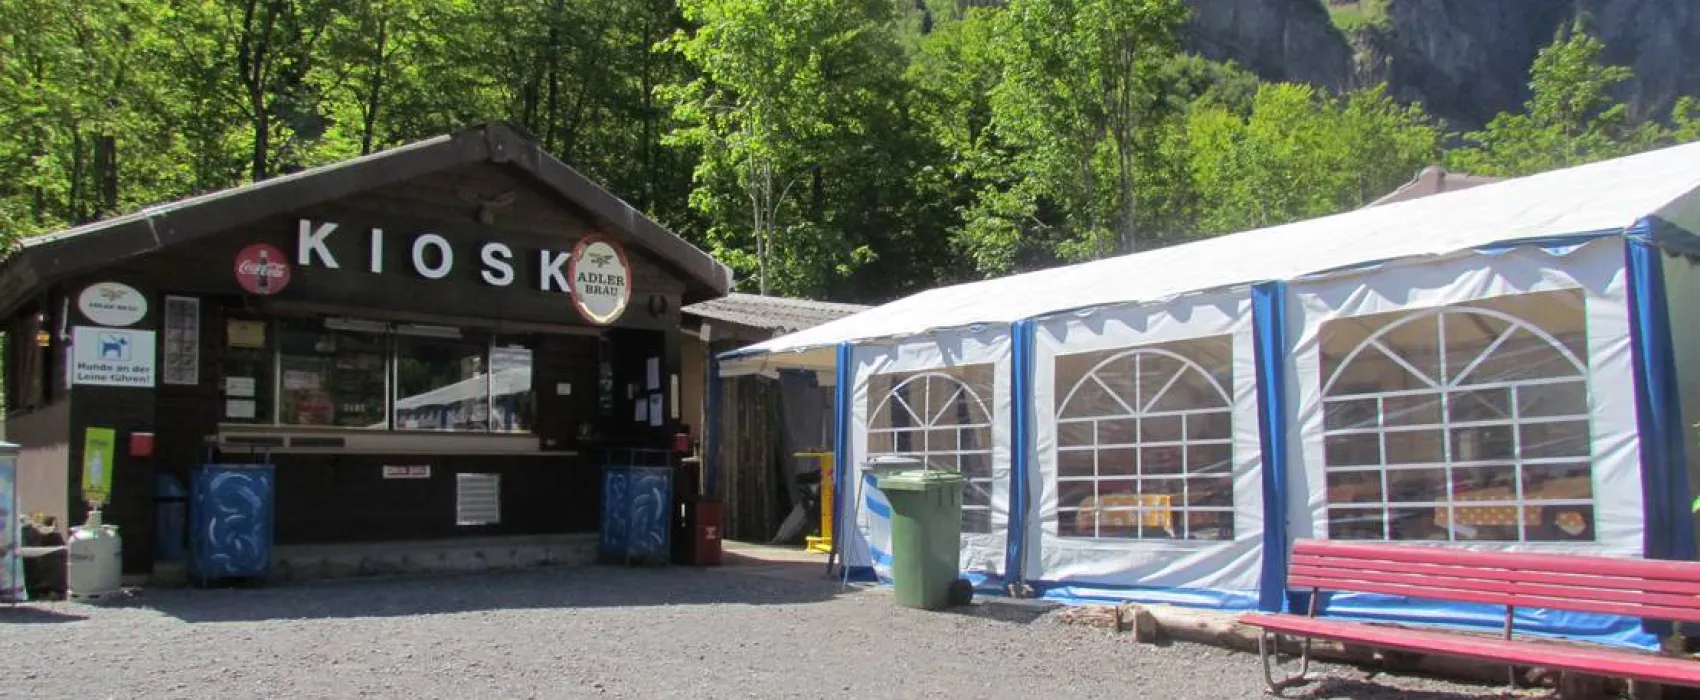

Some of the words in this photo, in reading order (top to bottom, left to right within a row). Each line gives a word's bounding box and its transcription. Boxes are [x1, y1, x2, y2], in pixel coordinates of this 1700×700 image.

[297, 219, 572, 292] KIOSK
[577, 271, 625, 287] ADLER
[77, 362, 113, 372] Hunde
[116, 364, 130, 373] an
[132, 364, 151, 374] der
[77, 372, 107, 381] Leine
